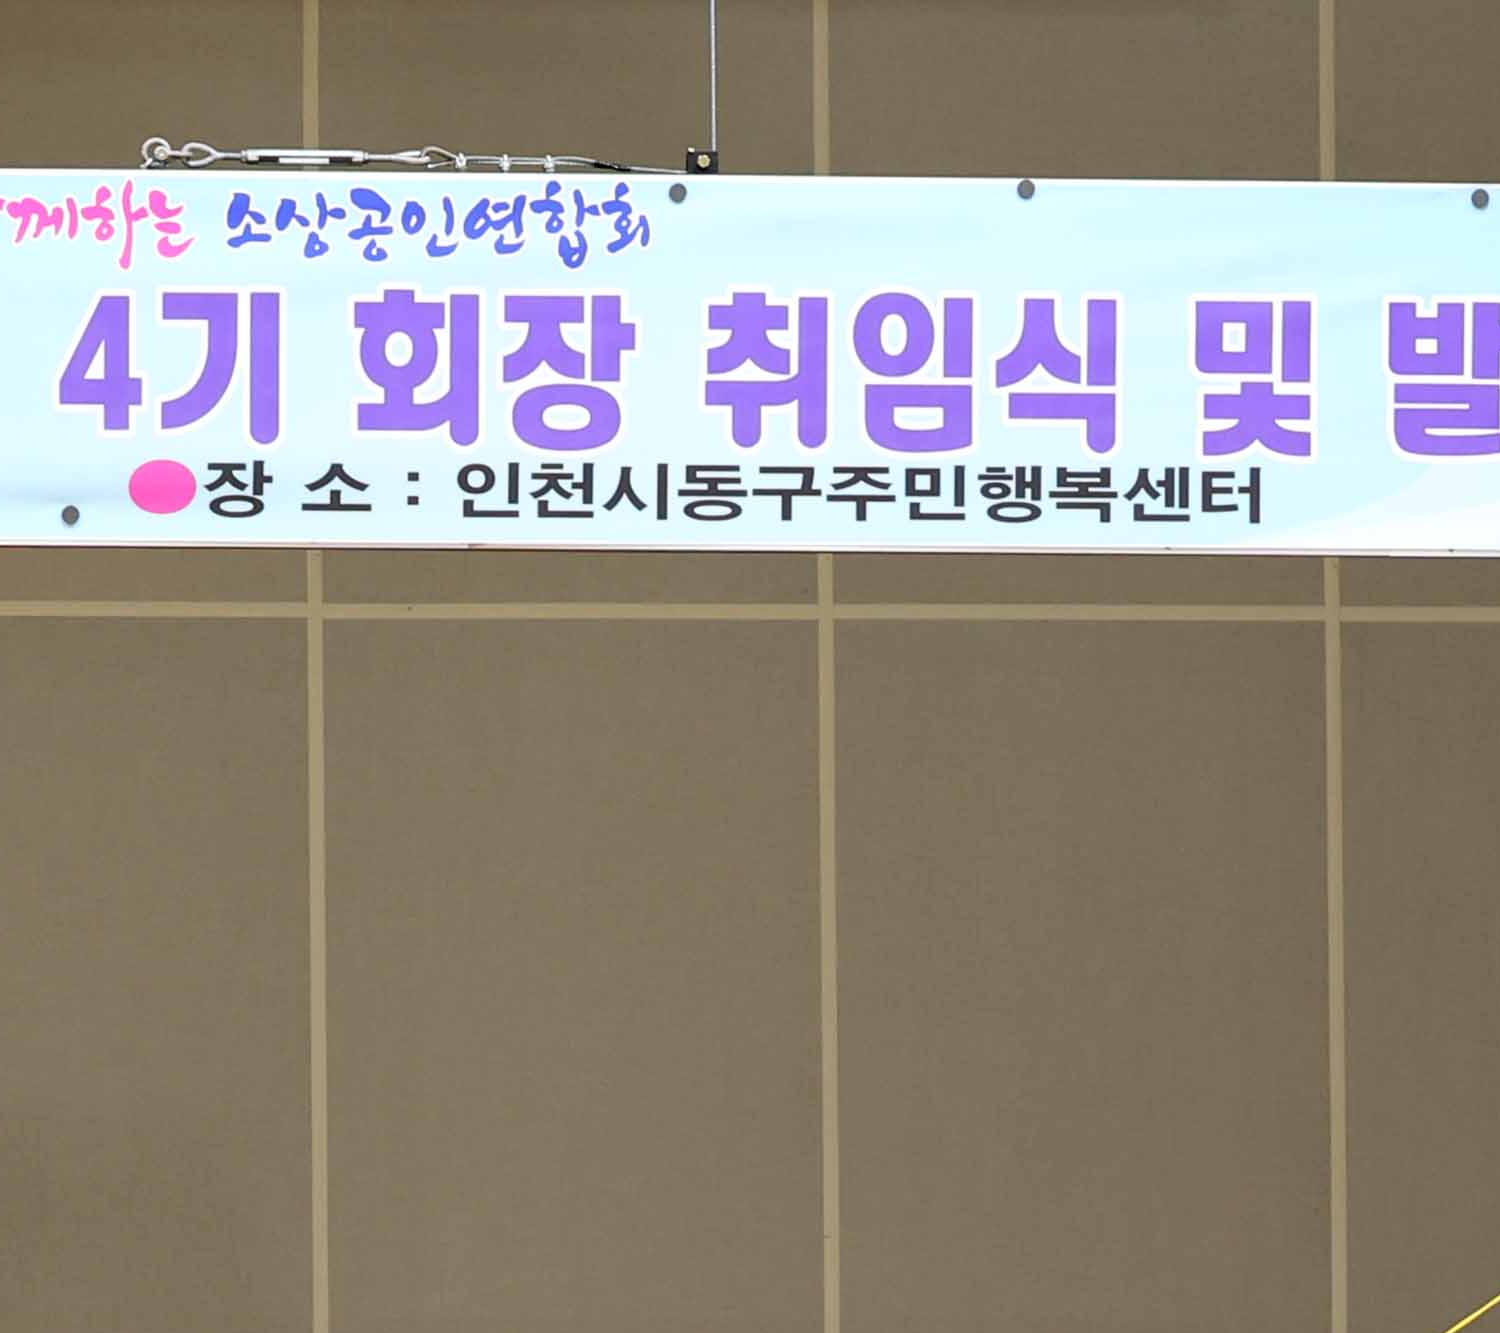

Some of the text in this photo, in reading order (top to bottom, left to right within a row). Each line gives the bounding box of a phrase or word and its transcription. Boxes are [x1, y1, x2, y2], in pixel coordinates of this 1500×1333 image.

[226, 179, 651, 267] 소상공인연합회
[59, 291, 281, 446] 4기
[353, 288, 637, 451] 회장
[704, 290, 1118, 455] 취임식
[1194, 299, 1312, 457] 및
[456, 461, 1262, 526] 인천시동구주민행복센터
